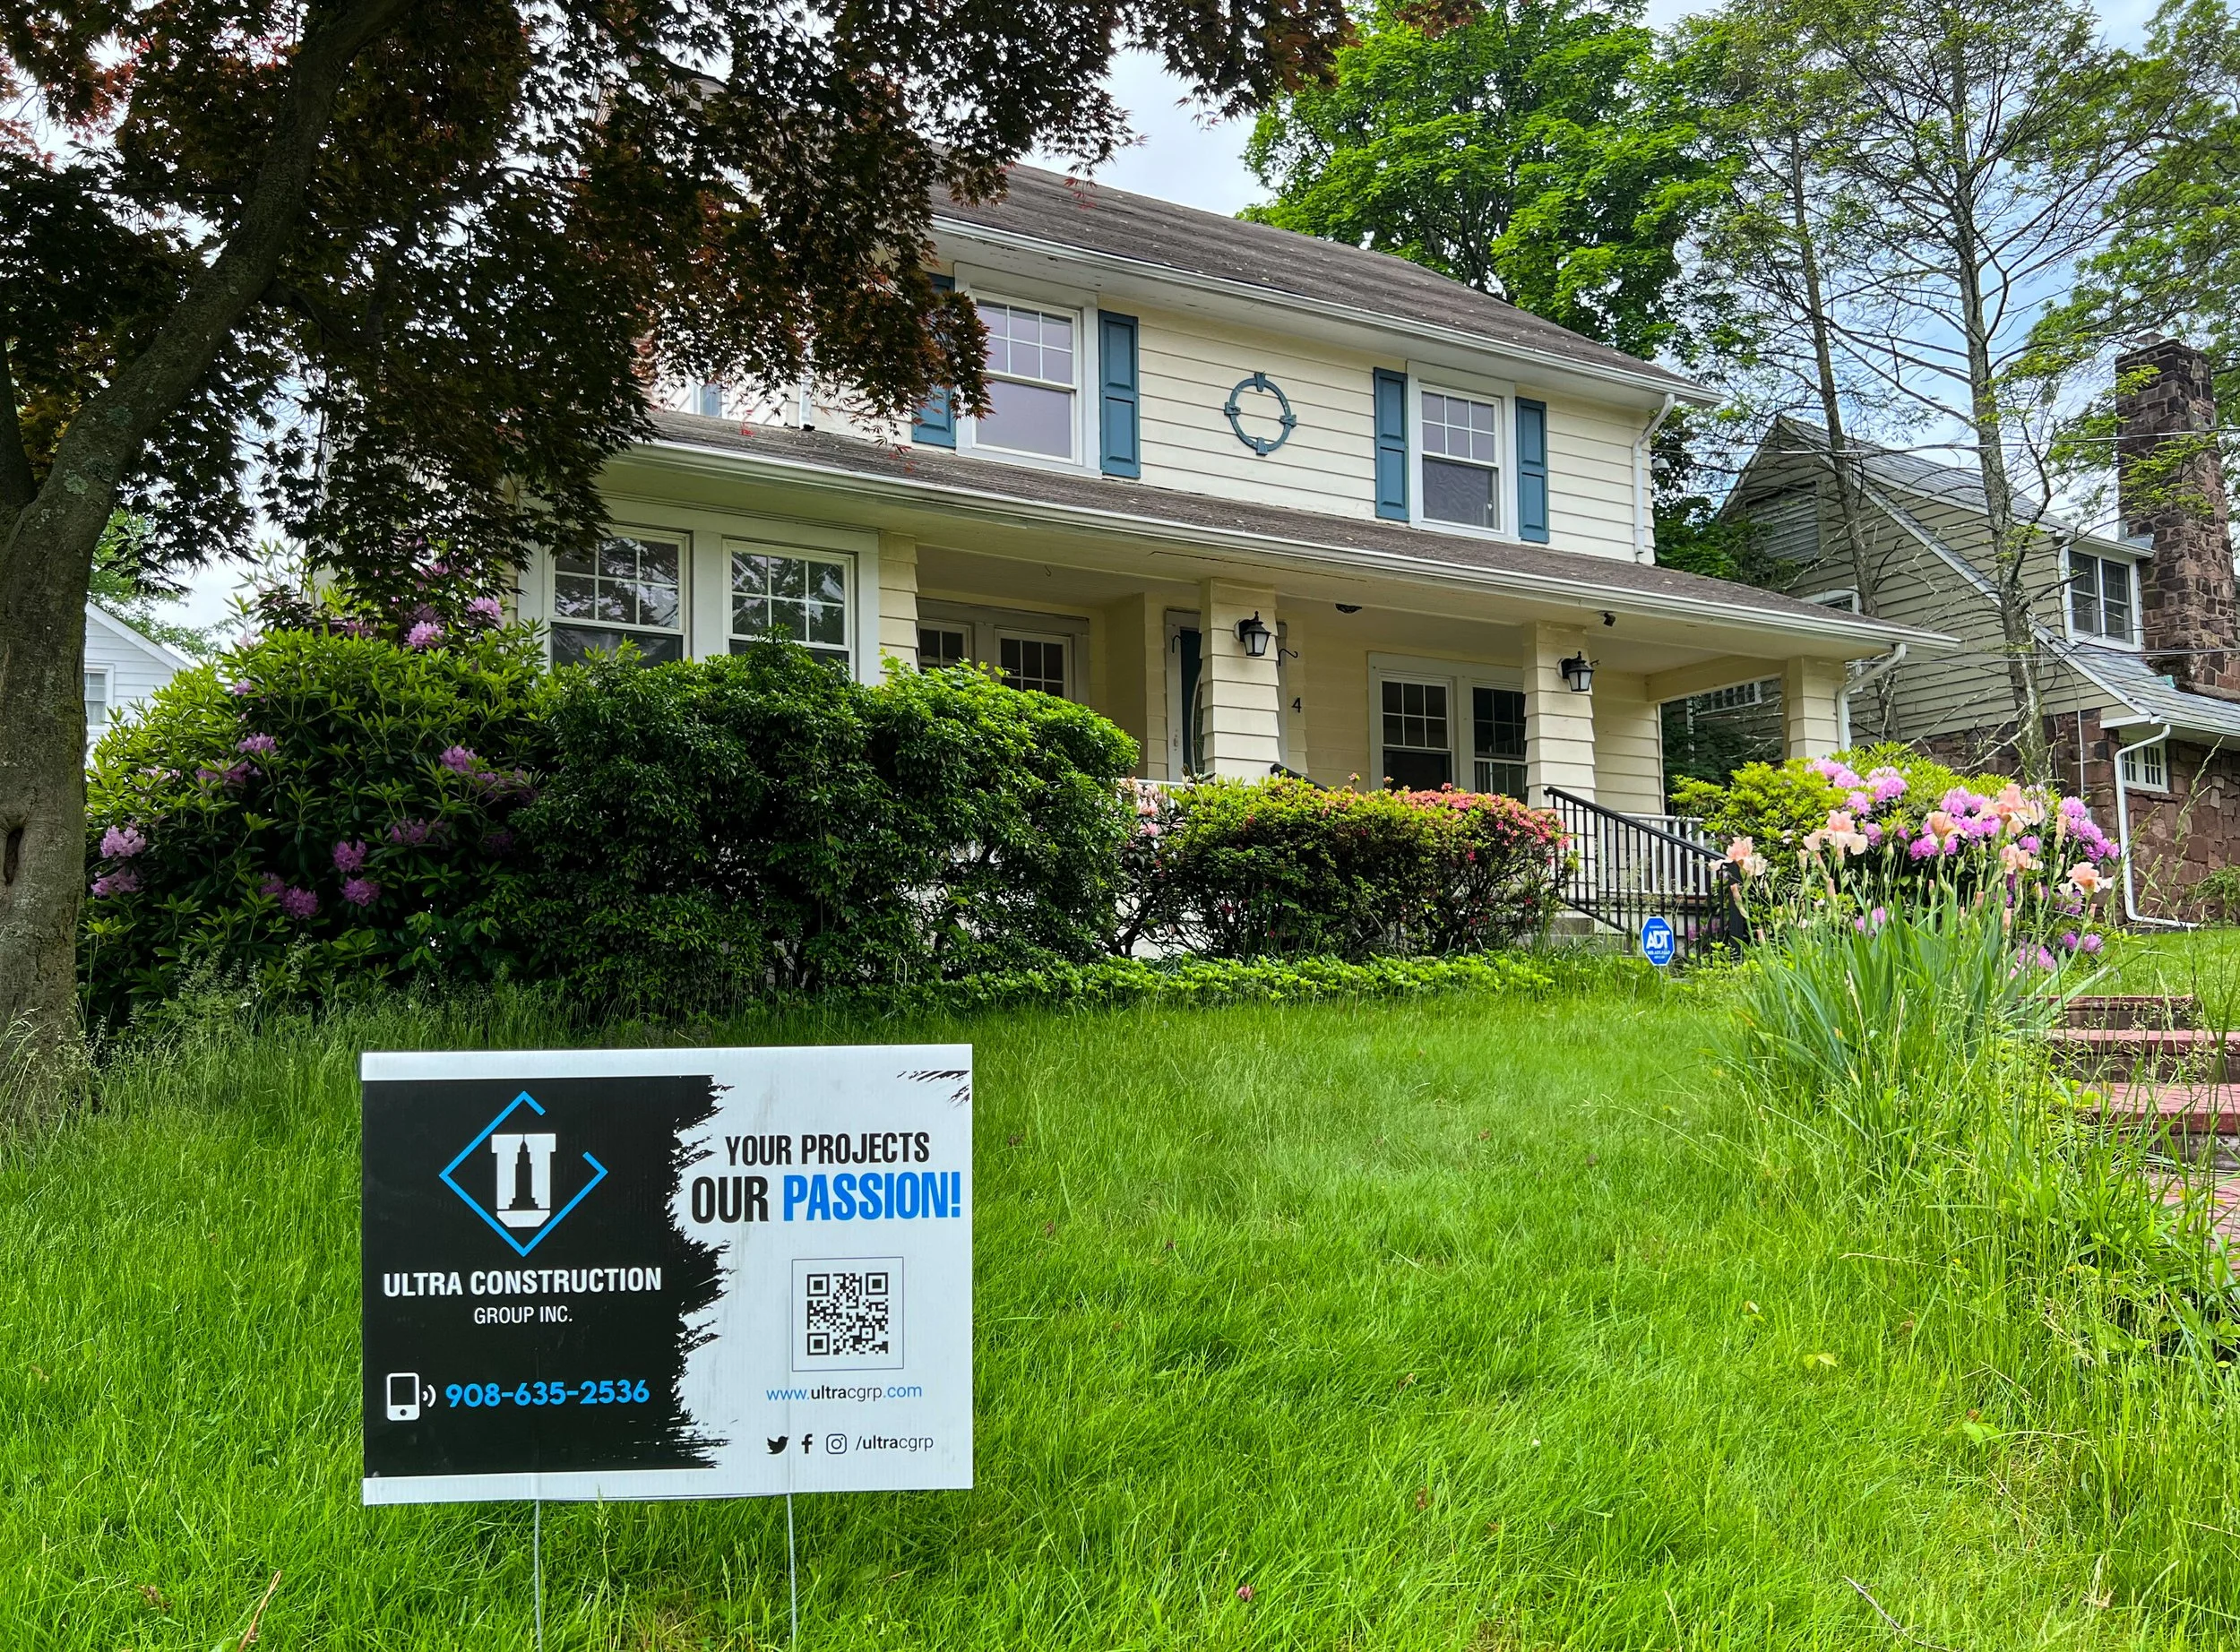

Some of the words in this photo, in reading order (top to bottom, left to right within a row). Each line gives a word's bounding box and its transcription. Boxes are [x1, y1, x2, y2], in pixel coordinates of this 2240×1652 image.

[1291, 697, 1302, 713] 4
[1646, 930, 1670, 949] ADT
[725, 1134, 792, 1166] YOUR
[801, 1131, 930, 1165] PROJECTS
[691, 1175, 769, 1224] OUR
[783, 1172, 961, 1222] PASSION!
[383, 1271, 463, 1297] ULTRA
[470, 1267, 662, 1295] CONSTRUCTION
[474, 1306, 535, 1324] GROUP
[539, 1305, 573, 1323] INC.
[445, 1379, 650, 1407] 908-635-2536
[766, 1385, 923, 1402] www.ultracgrp.com
[855, 1435, 934, 1451] /ultracgrp
